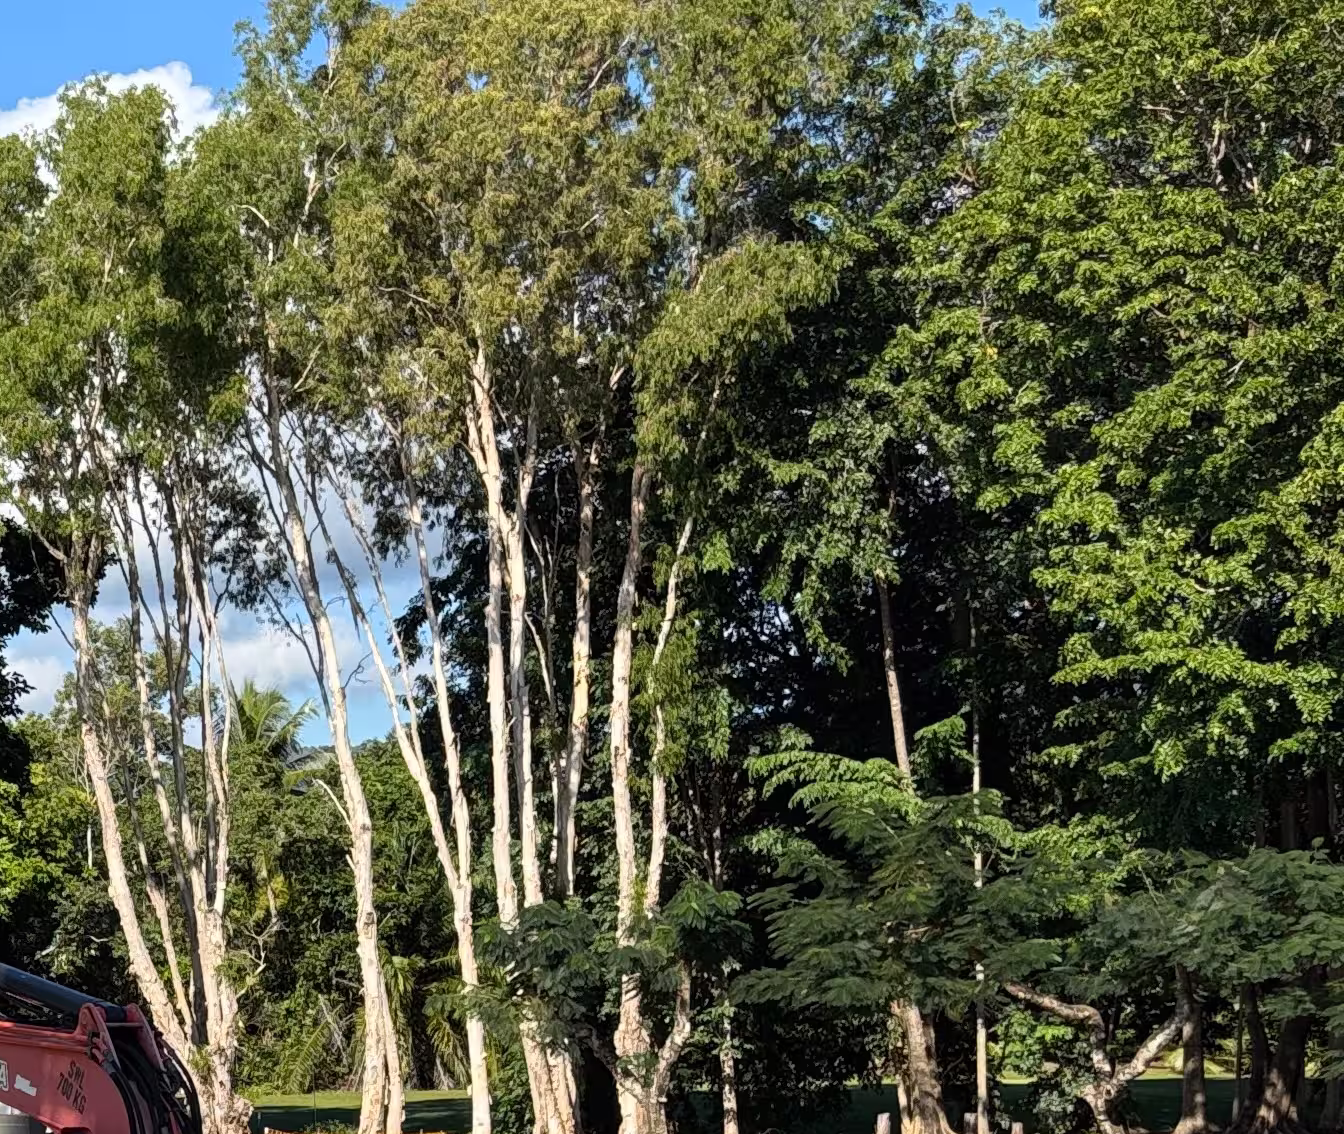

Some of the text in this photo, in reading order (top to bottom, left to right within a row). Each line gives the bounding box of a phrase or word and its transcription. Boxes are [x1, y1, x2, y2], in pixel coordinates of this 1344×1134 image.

[57, 1071, 87, 1115] 700 KG
[68, 1060, 85, 1090] SWL
